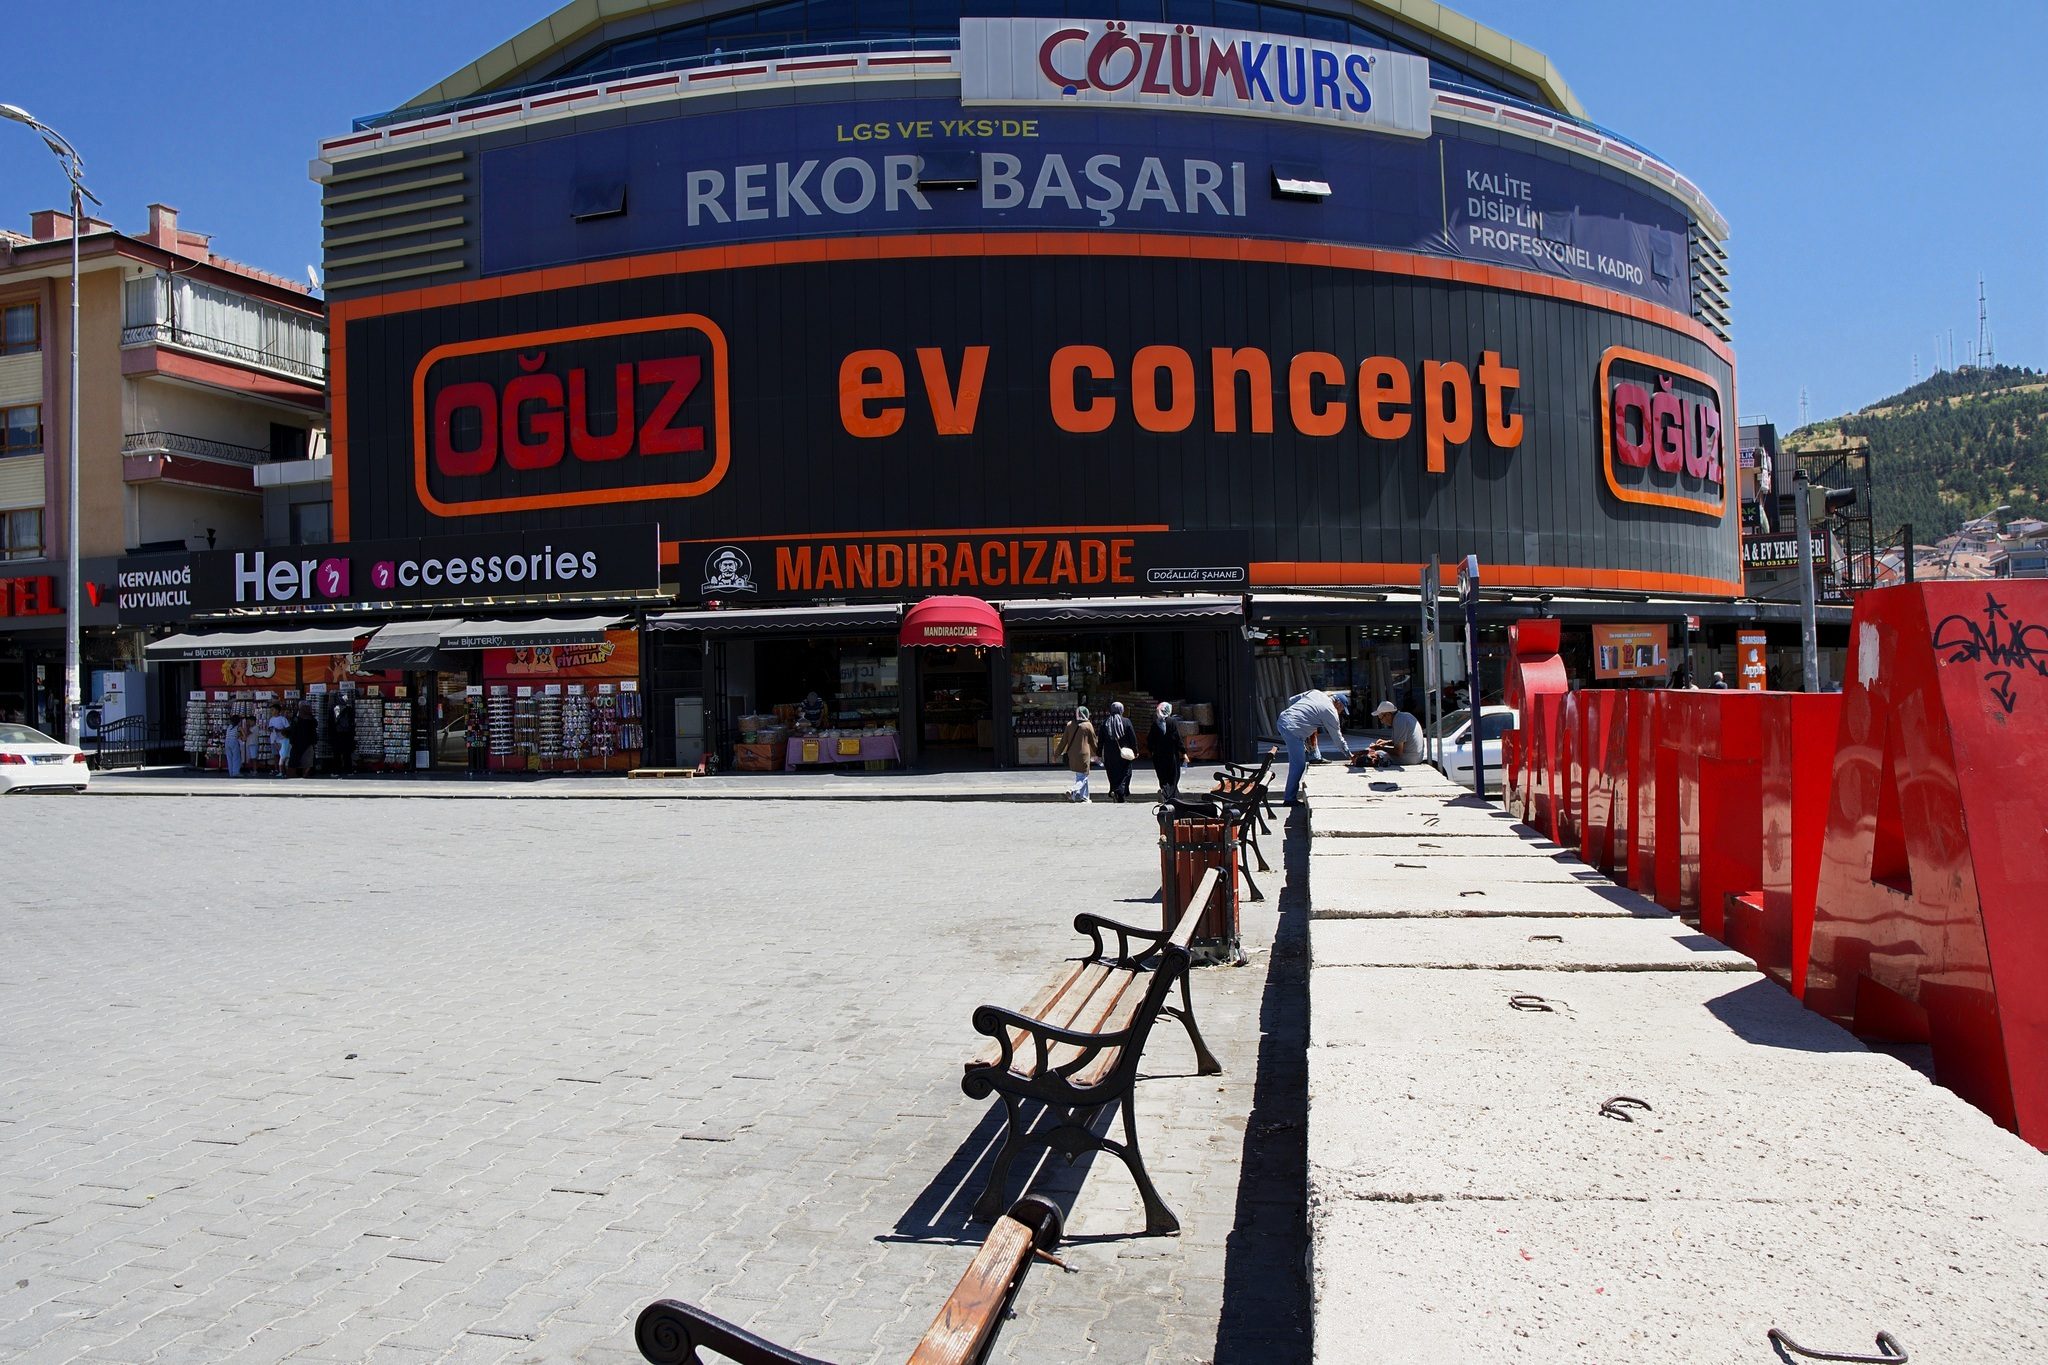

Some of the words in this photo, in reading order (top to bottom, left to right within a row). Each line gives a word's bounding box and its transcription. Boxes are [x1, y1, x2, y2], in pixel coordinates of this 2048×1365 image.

[837, 123, 891, 142] LGS
[896, 121, 933, 138] VE
[686, 155, 932, 227] REKOR
[981, 153, 1248, 228] BAŞARI
[1466, 169, 1532, 202] KALİTE
[1468, 197, 1543, 231] DİSİPLİN
[1469, 225, 1595, 271] PROFESYONEL
[1598, 255, 1643, 286] KADRO
[434, 351, 706, 477] OĞUZ
[838, 345, 991, 438] ev
[1049, 345, 1525, 474] concept
[1614, 374, 1722, 485] OĞUZ
[775, 538, 1136, 592] MANDIRACIZADE
[1760, 542, 1772, 560] EV
[1773, 534, 1826, 559] YEMEERİ
[371, 545, 598, 590] accessories
[1153, 569, 1200, 580] DOĞALLIĞI
[1201, 570, 1238, 581] ŞAHANE
[923, 626, 978, 637] MANDIRACIZADE
[1743, 663, 1767, 678] Apple
